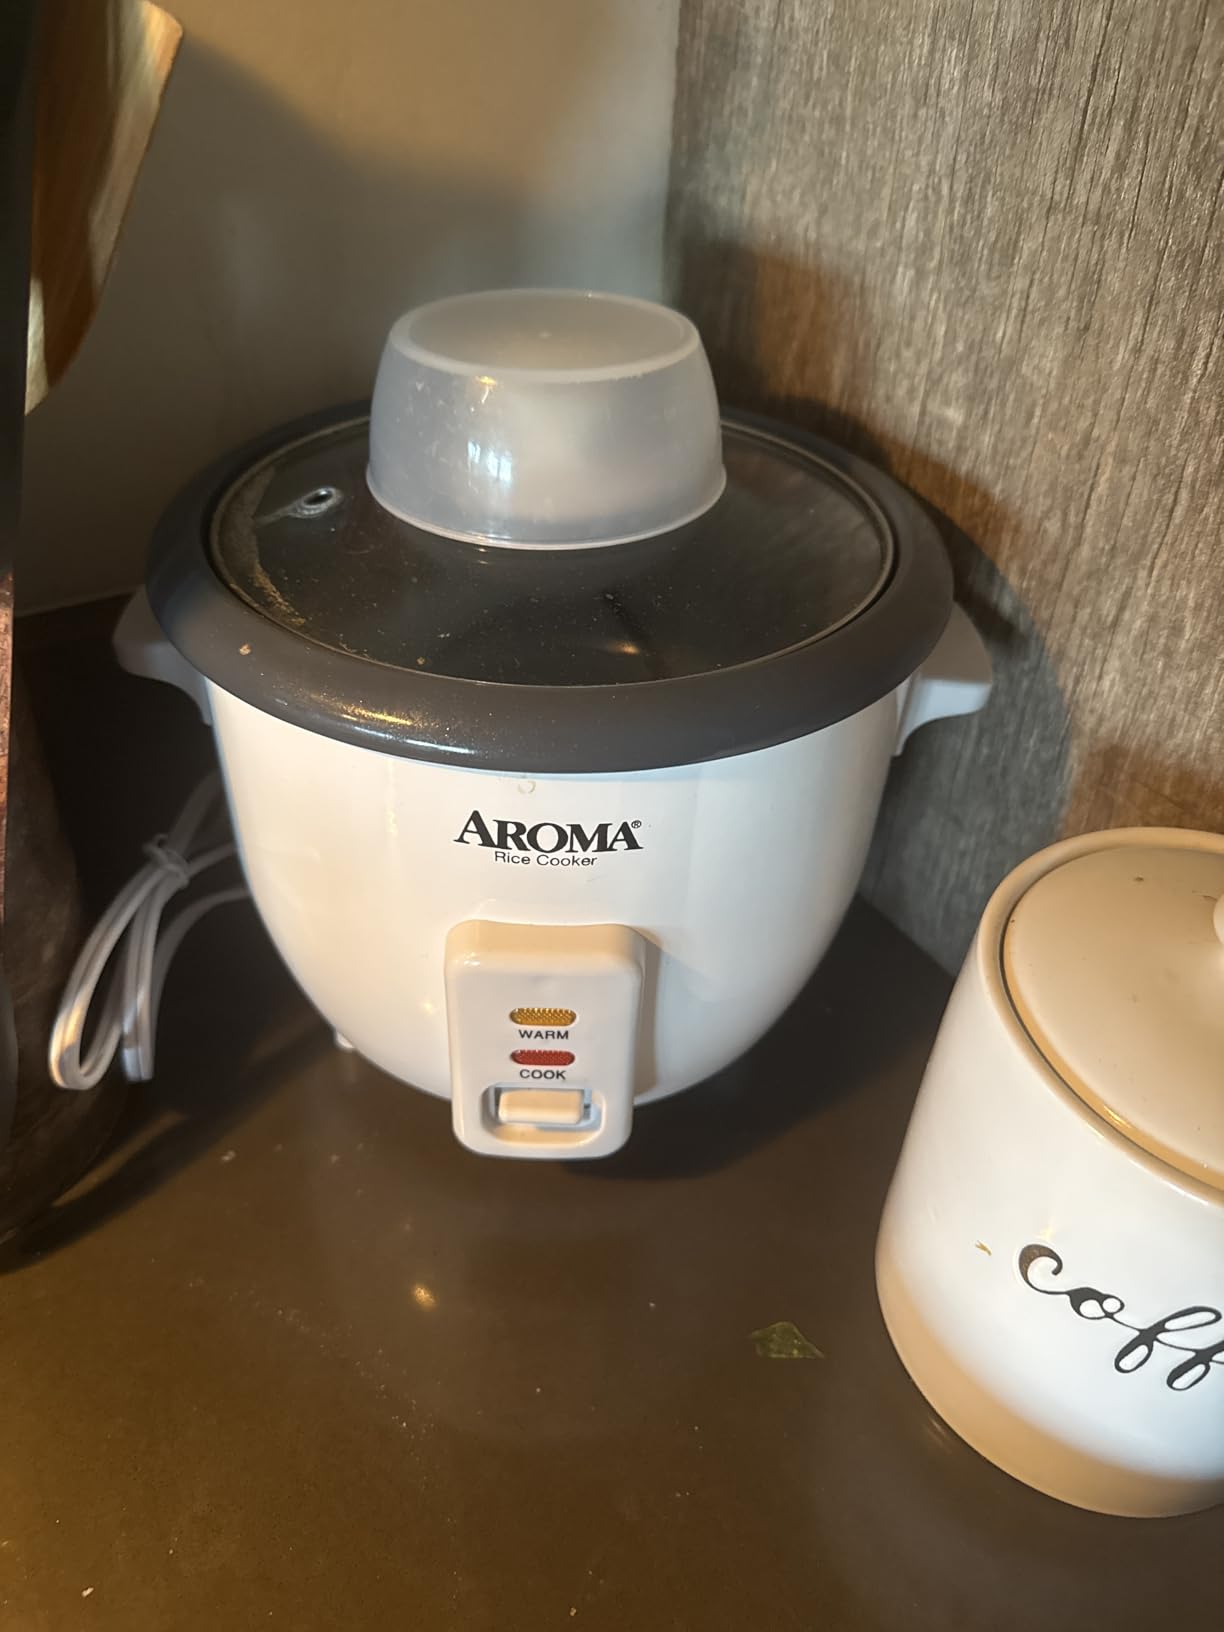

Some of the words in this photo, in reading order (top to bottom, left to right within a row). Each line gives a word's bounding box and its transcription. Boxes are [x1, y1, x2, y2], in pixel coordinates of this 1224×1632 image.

[494, 851, 531, 865] Rice
[536, 854, 598, 867] Cooker
[518, 1029, 569, 1040] WARM
[519, 1069, 567, 1080] COOK
